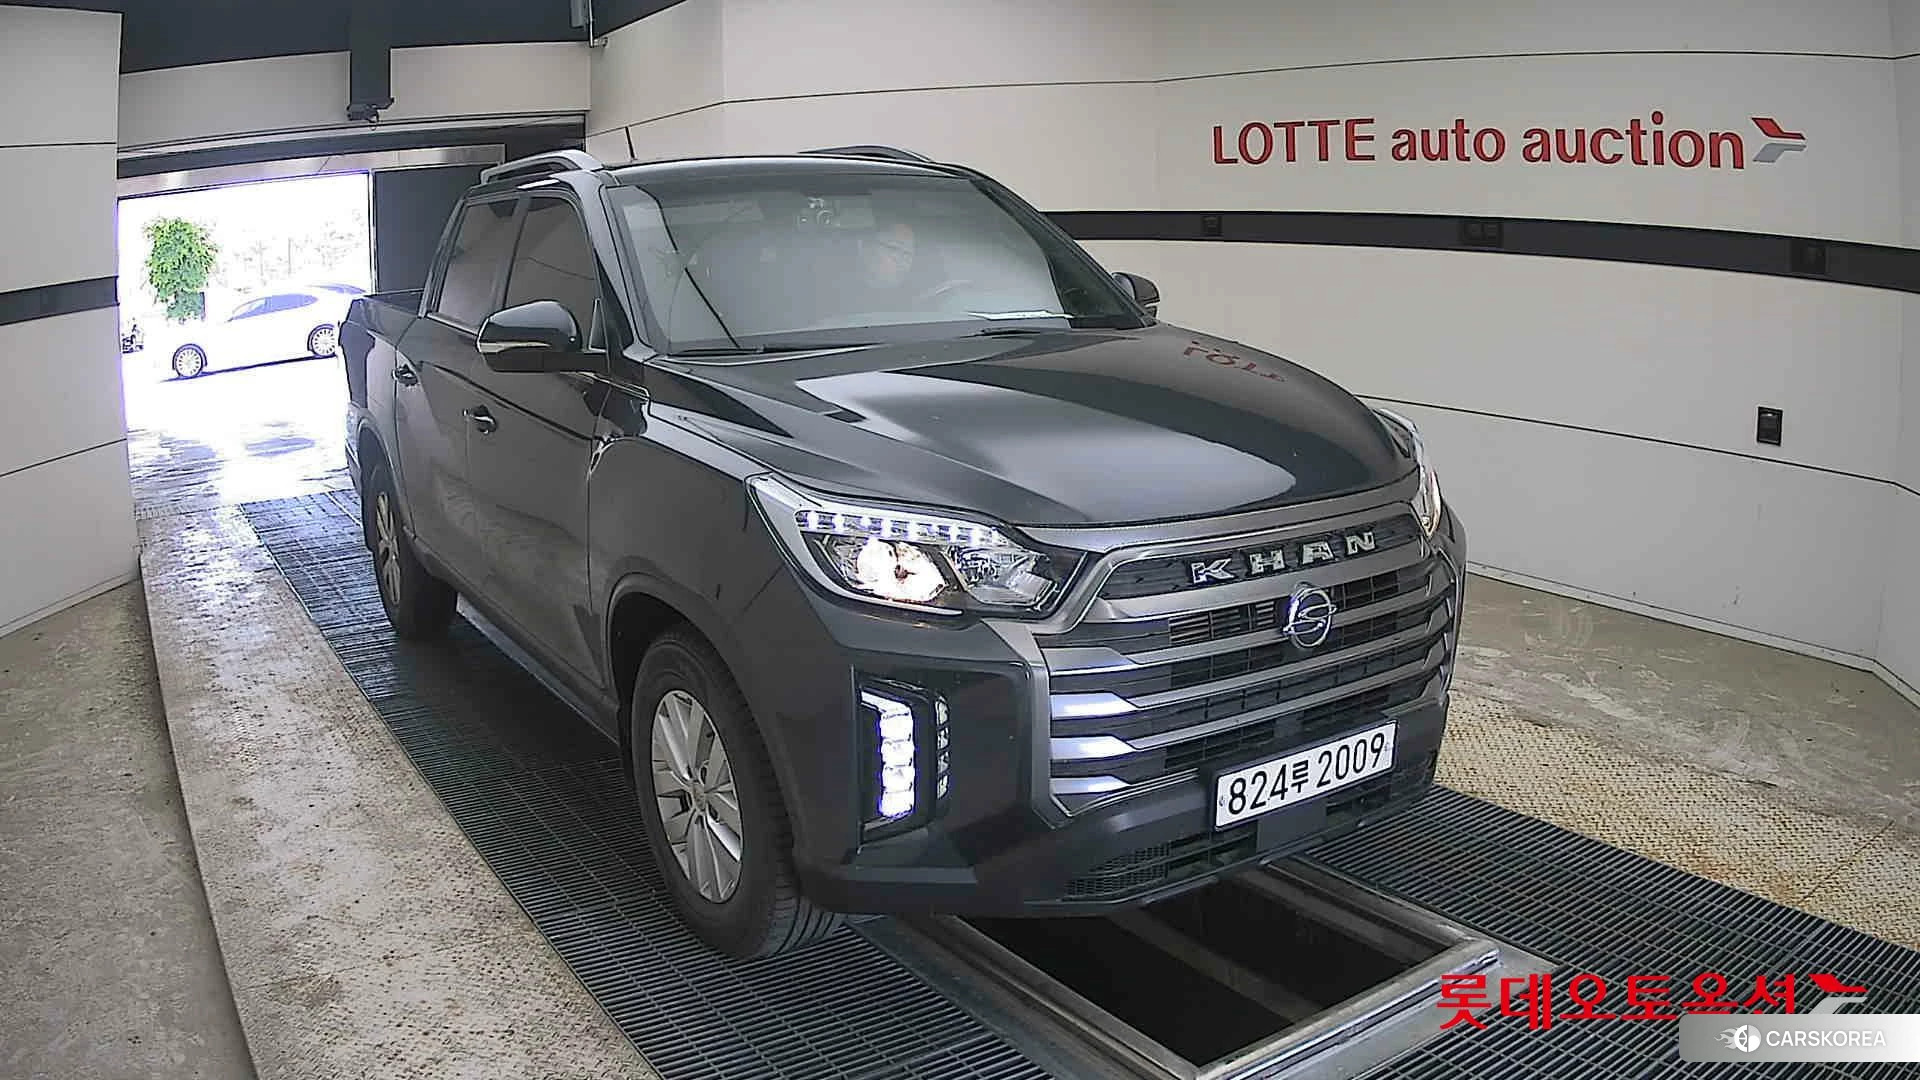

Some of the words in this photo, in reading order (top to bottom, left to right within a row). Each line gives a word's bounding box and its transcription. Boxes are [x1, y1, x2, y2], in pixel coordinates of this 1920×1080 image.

[1212, 117, 1376, 165] LOTTE
[1391, 118, 1506, 162] auto
[1521, 111, 1745, 170] auction
[1190, 532, 1376, 584] KHAN
